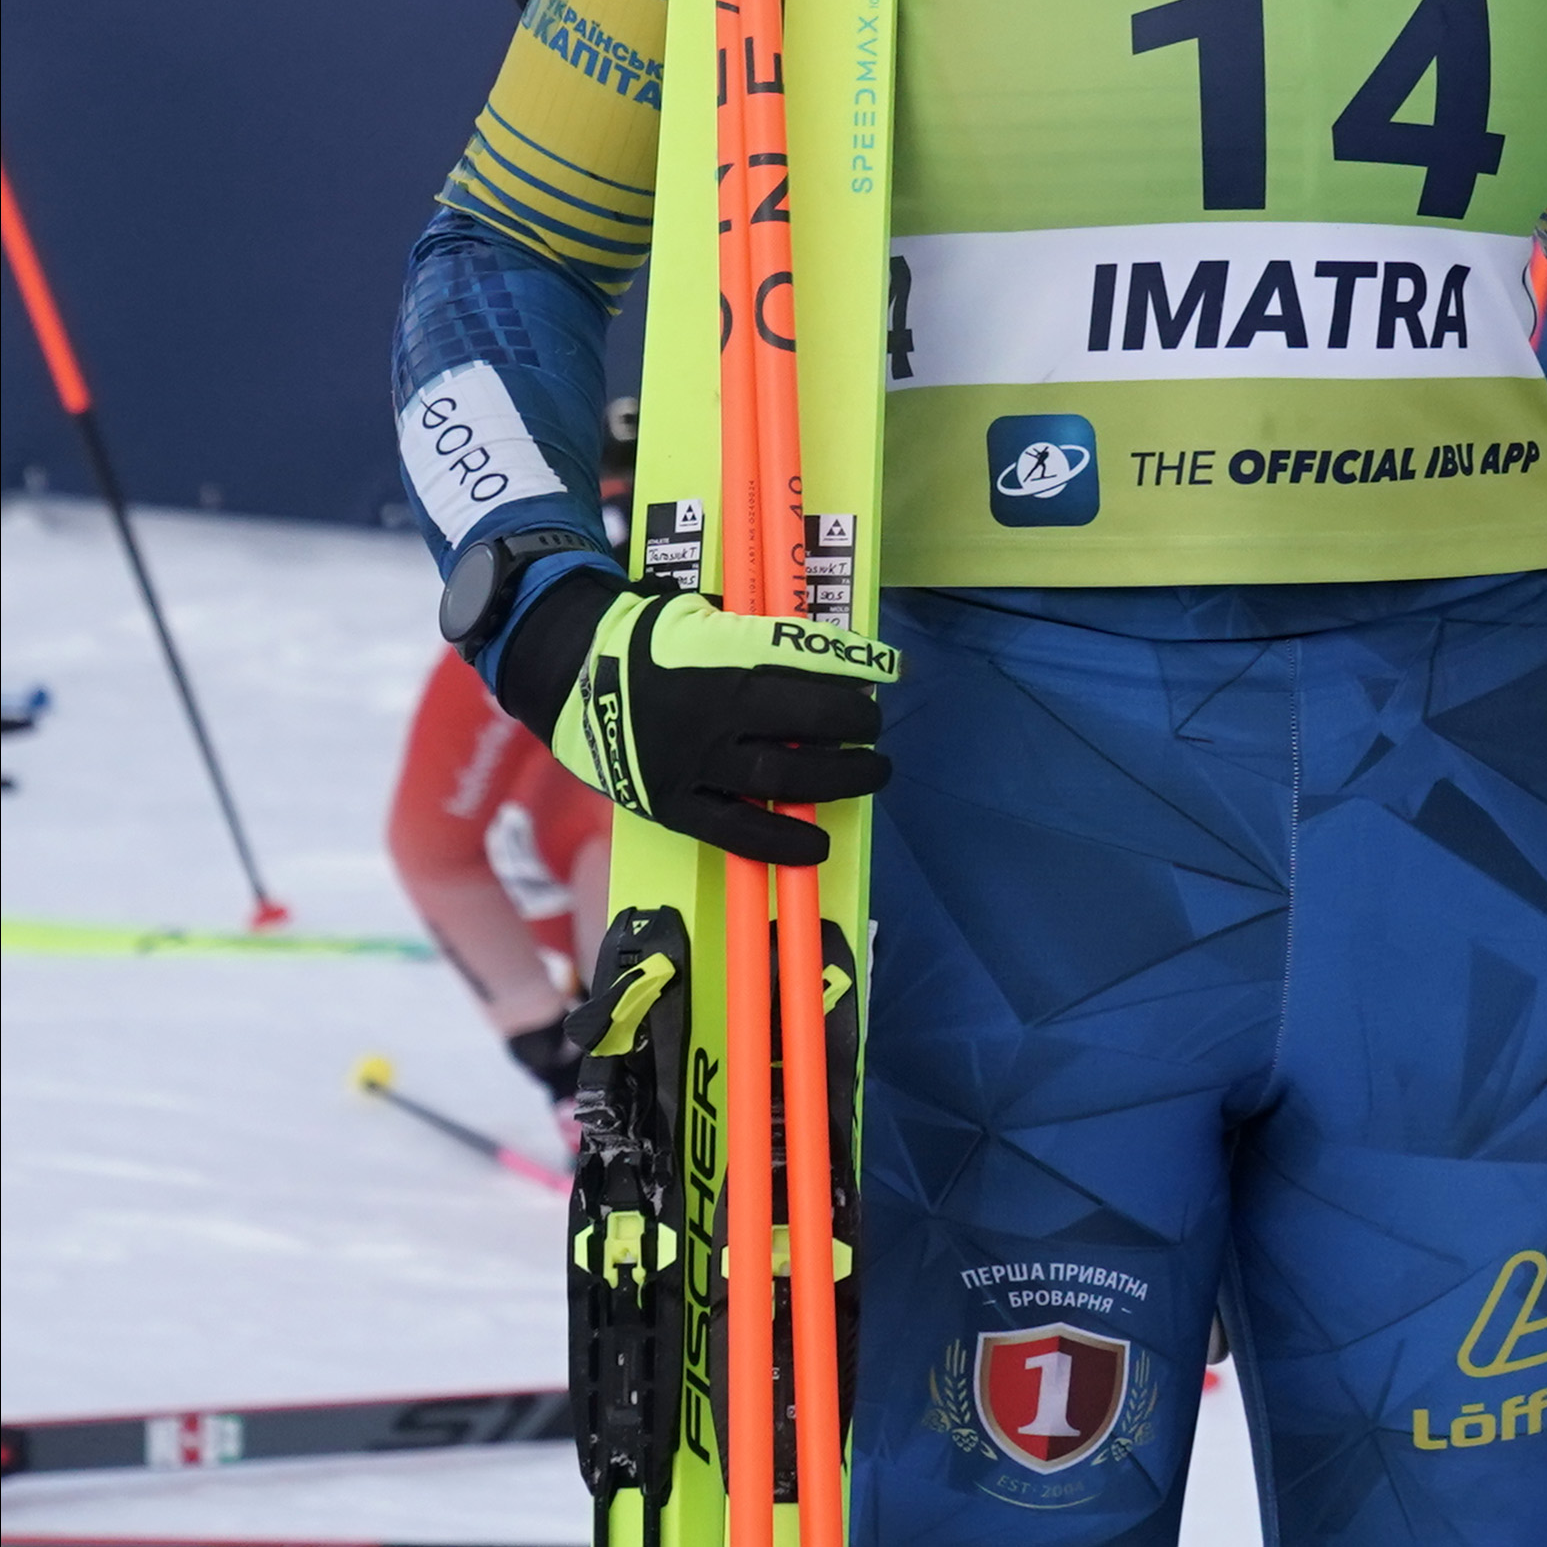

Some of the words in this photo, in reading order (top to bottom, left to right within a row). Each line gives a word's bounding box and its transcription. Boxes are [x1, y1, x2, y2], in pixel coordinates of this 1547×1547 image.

[533, 9, 664, 112] КАПІТА
[851, 15, 880, 195] SPEEDMAX
[1087, 259, 1471, 353] IMATRA
[1131, 451, 1219, 487] THE
[1228, 446, 1418, 486] OFFICIAL
[1424, 442, 1476, 480] IBU
[1479, 440, 1542, 476] APP
[685, 1046, 721, 1466] FISCHER
[960, 1263, 1045, 1290] ПЕРША
[1049, 1263, 1149, 1301] ПРИВАТНА
[1007, 1290, 1115, 1314] БРОВАРНЯ
[1017, 1351, 1083, 1438] 1
